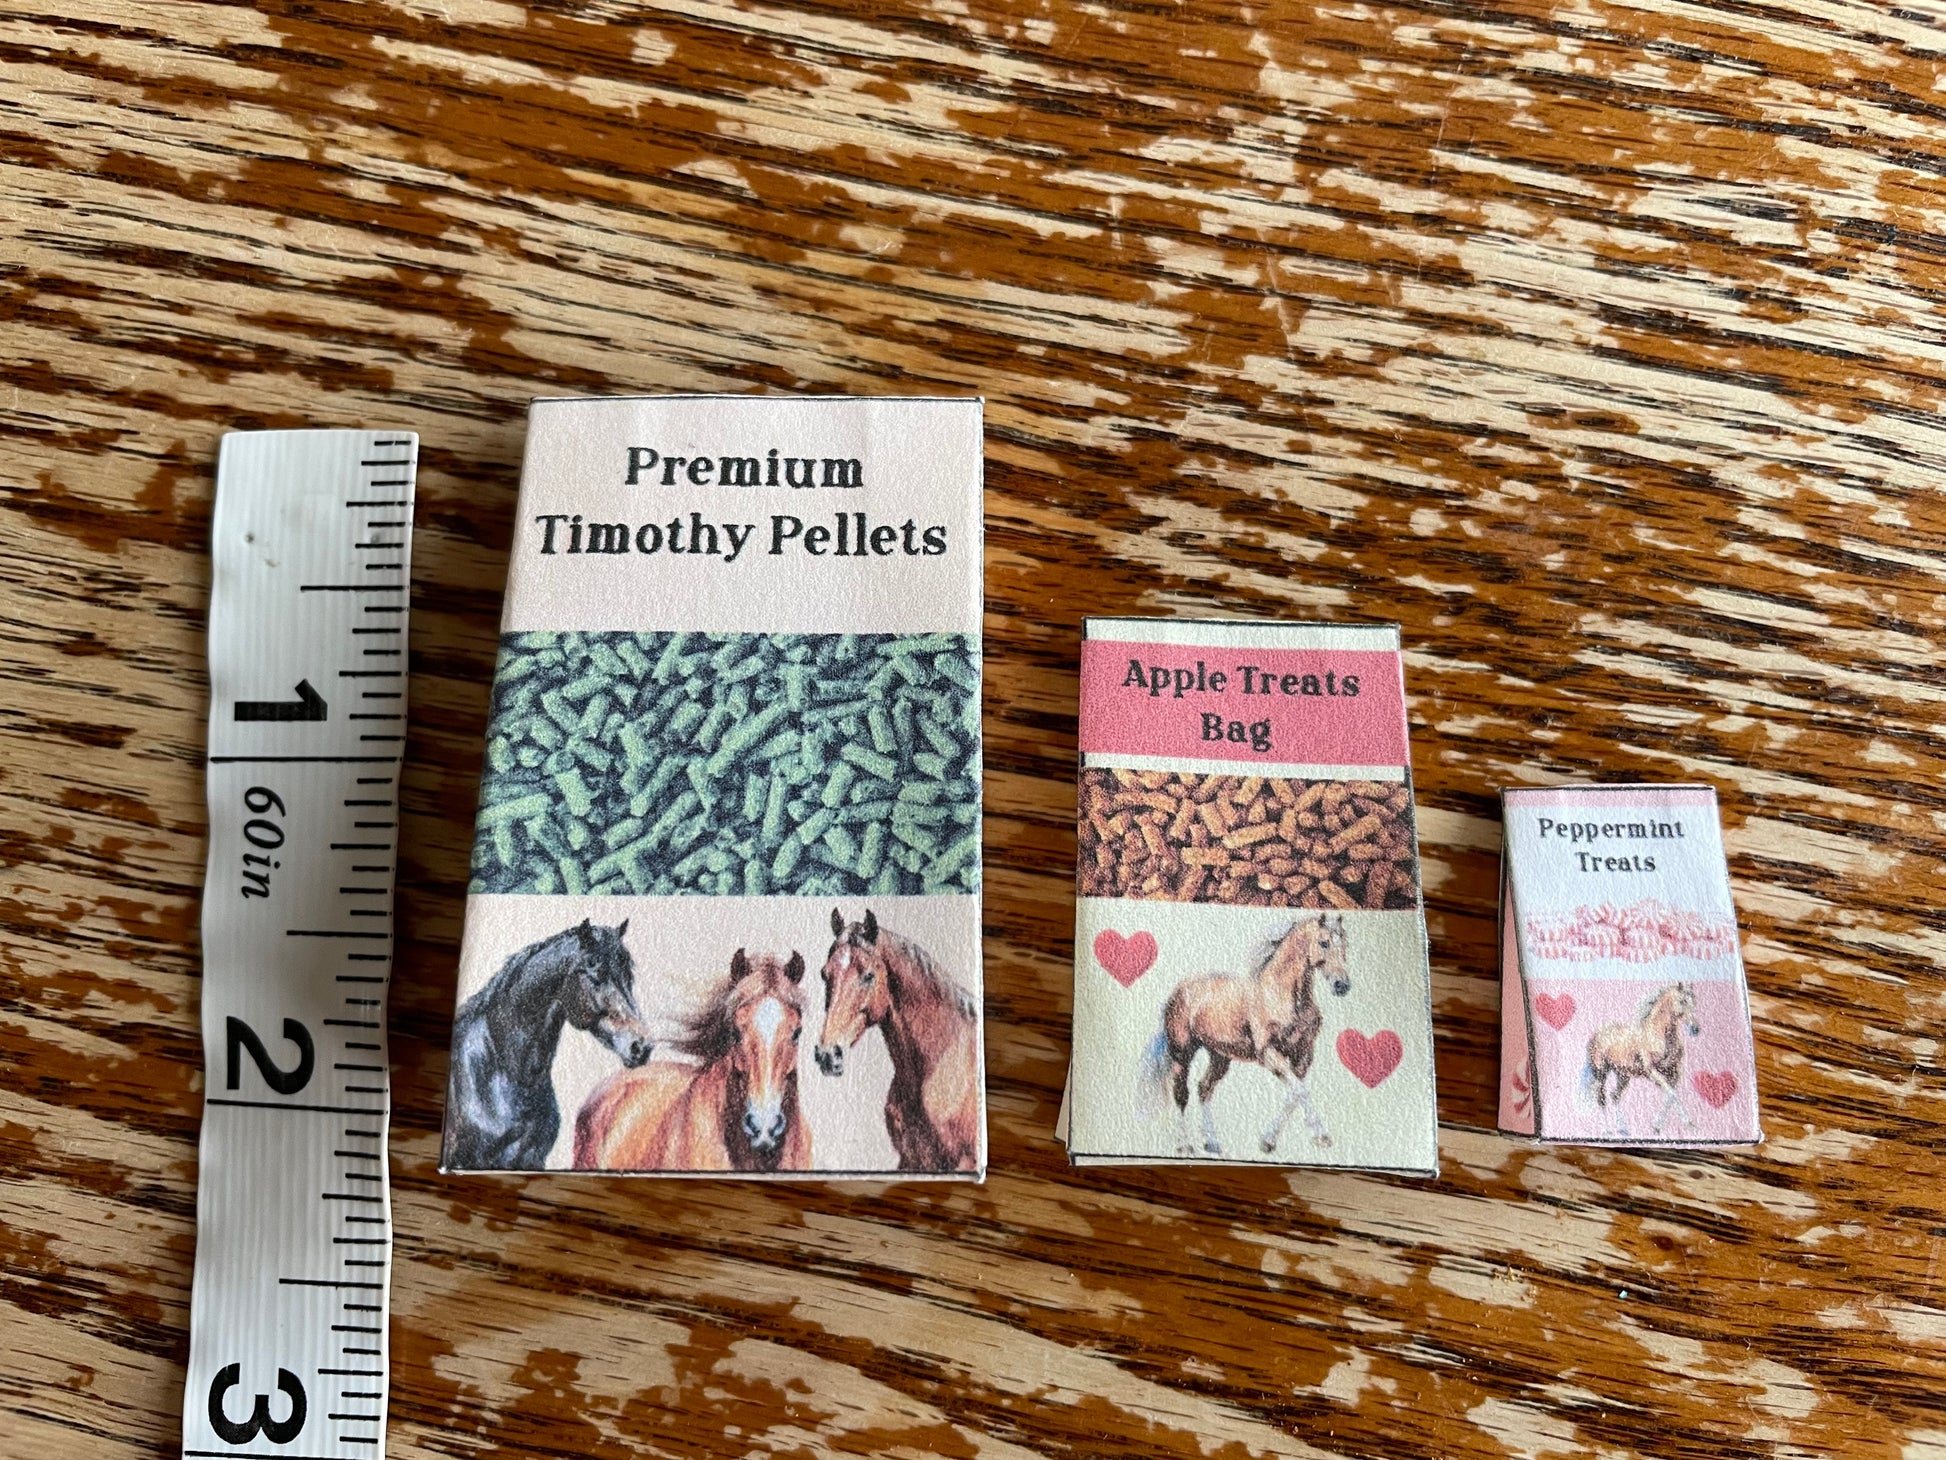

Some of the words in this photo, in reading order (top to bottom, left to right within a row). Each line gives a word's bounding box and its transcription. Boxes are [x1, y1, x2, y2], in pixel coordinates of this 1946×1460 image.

[624, 446, 865, 489] Premium
[535, 513, 756, 563] Timothy
[767, 512, 948, 557] Pellets
[1121, 658, 1228, 699] Apple
[1236, 664, 1362, 698] Treats
[234, 679, 328, 721] 1
[1199, 711, 1273, 753] Bag
[241, 786, 287, 899] 60in
[1537, 817, 1686, 844] Peppermint
[1575, 851, 1657, 873] Treats
[226, 1016, 315, 1095] 2
[208, 1362, 307, 1445] 3
